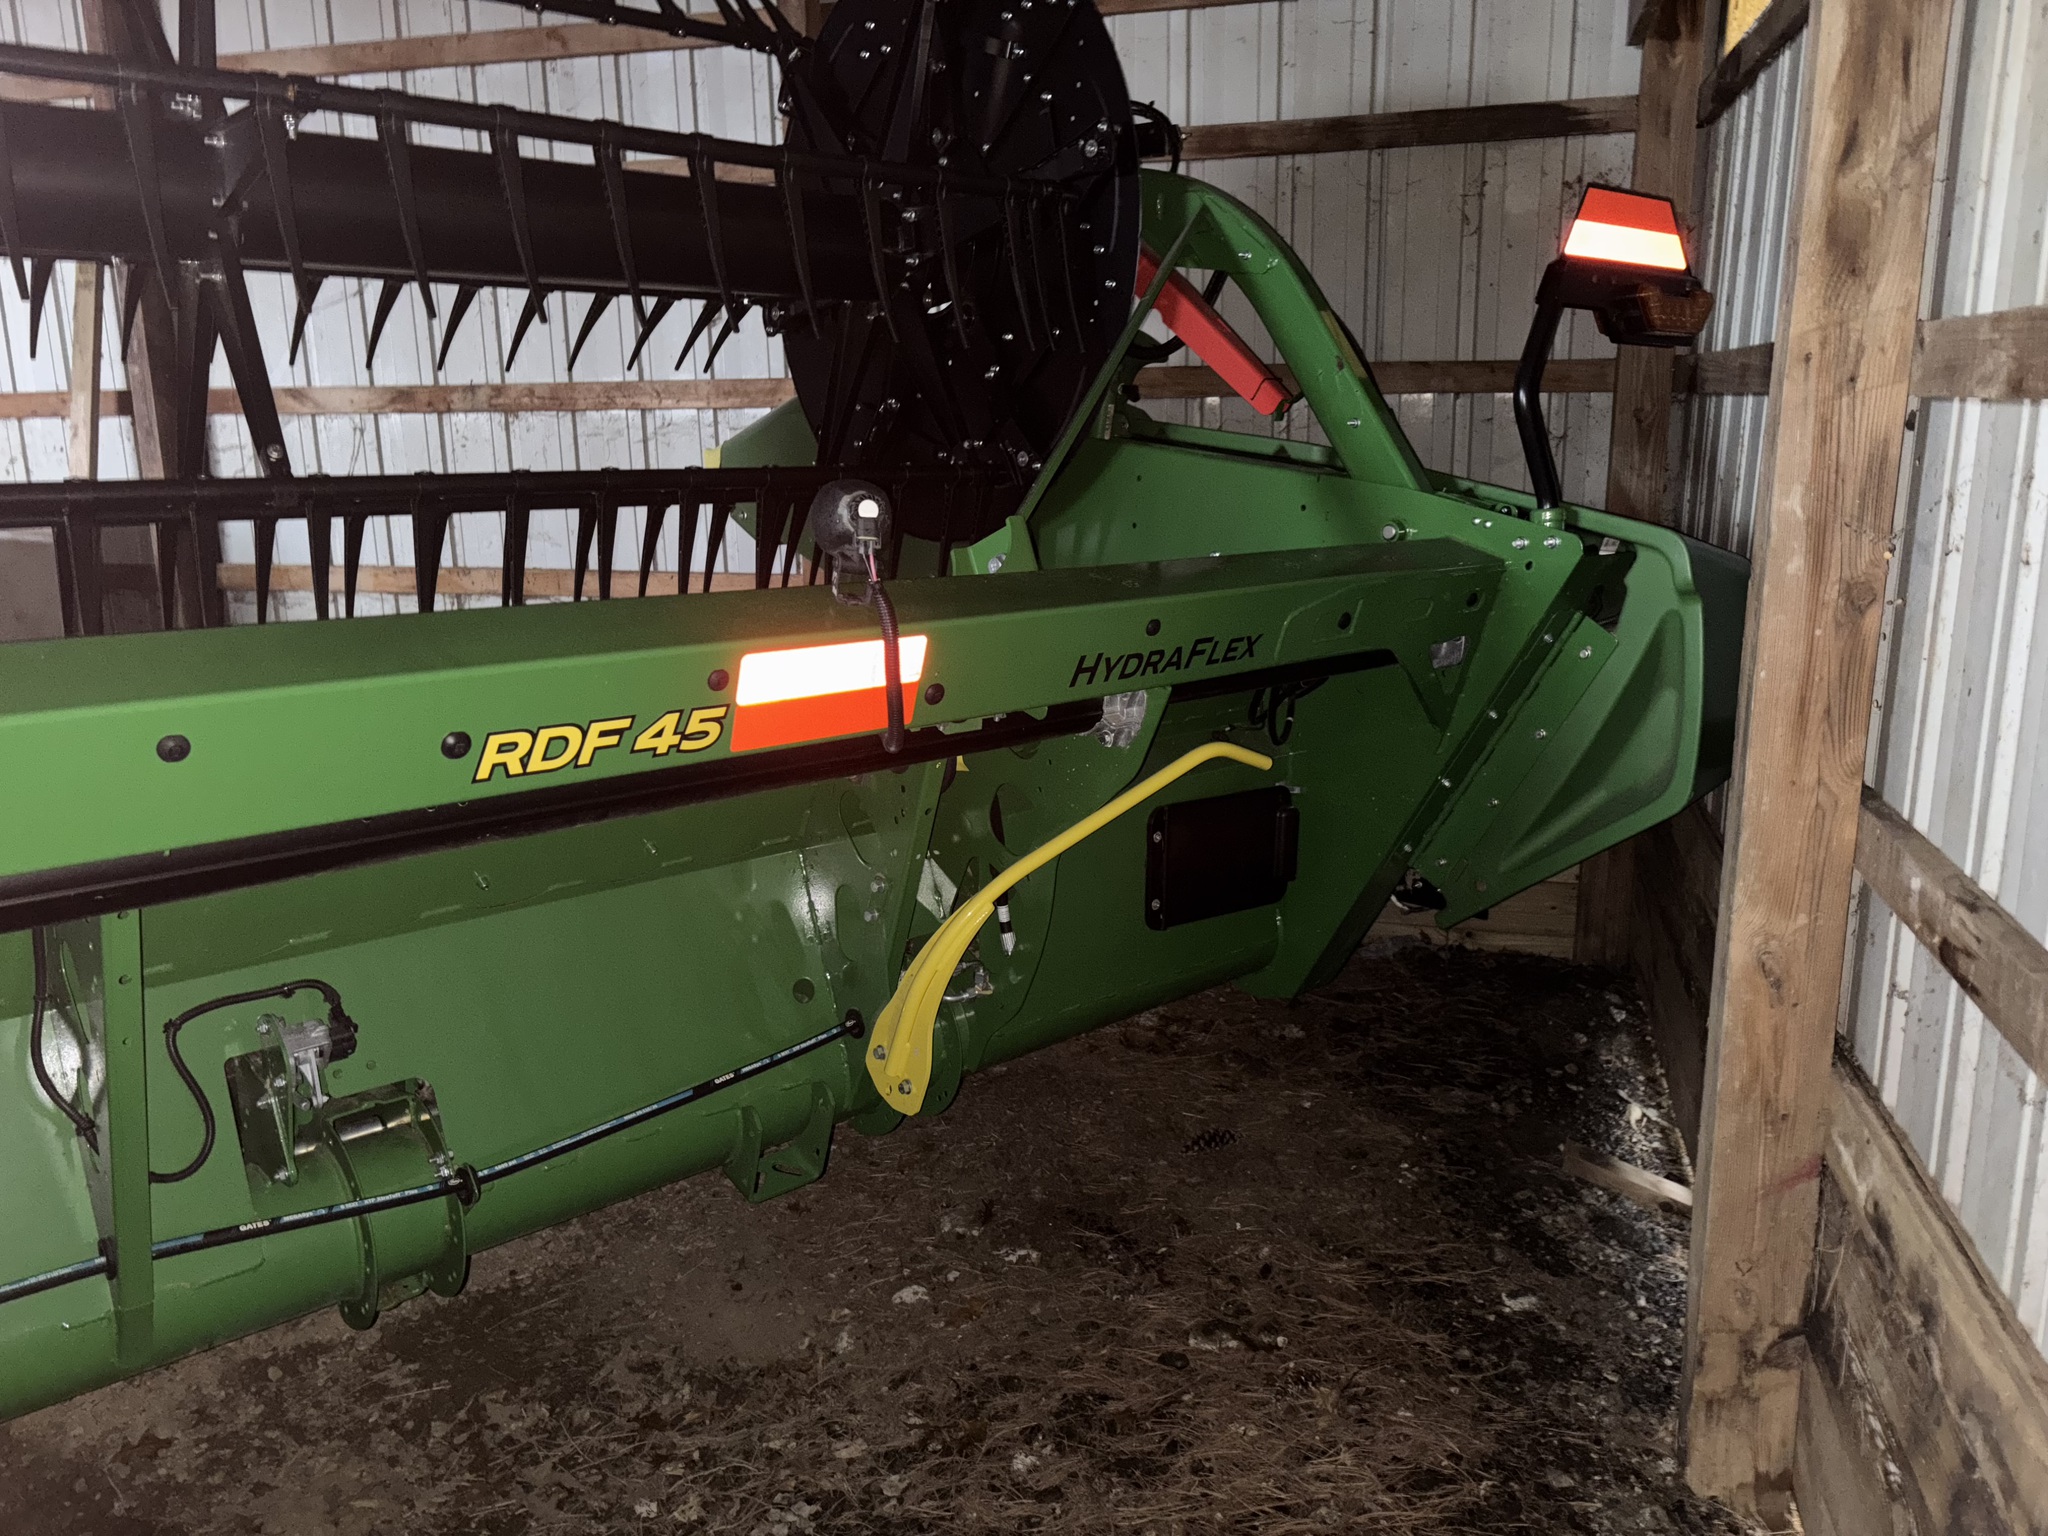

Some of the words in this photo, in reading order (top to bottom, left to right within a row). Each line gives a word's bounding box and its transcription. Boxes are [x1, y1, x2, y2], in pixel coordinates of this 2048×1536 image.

[471, 715, 636, 784] RDF
[630, 703, 731, 758] 45
[714, 1072, 735, 1084] GATES
[239, 1219, 271, 1231] GATES
